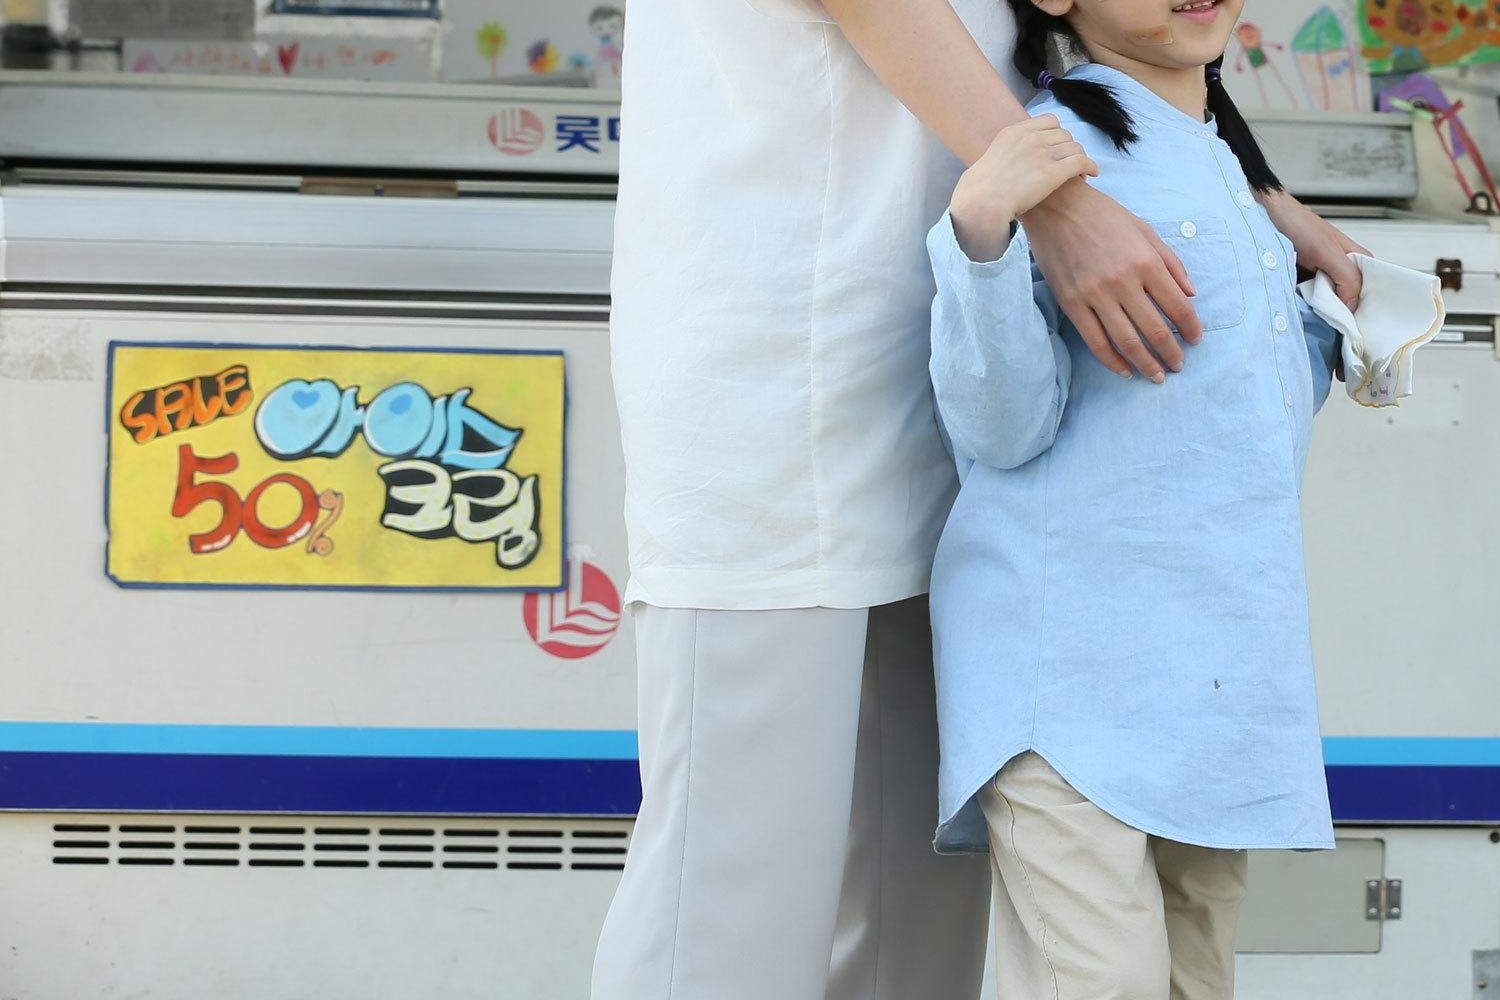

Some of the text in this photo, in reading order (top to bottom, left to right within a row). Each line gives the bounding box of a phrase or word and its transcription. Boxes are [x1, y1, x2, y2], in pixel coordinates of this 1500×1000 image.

[555, 114, 621, 154] 롯
[120, 363, 253, 445] SALE
[254, 377, 524, 469] 아이스
[171, 443, 343, 555] 50%
